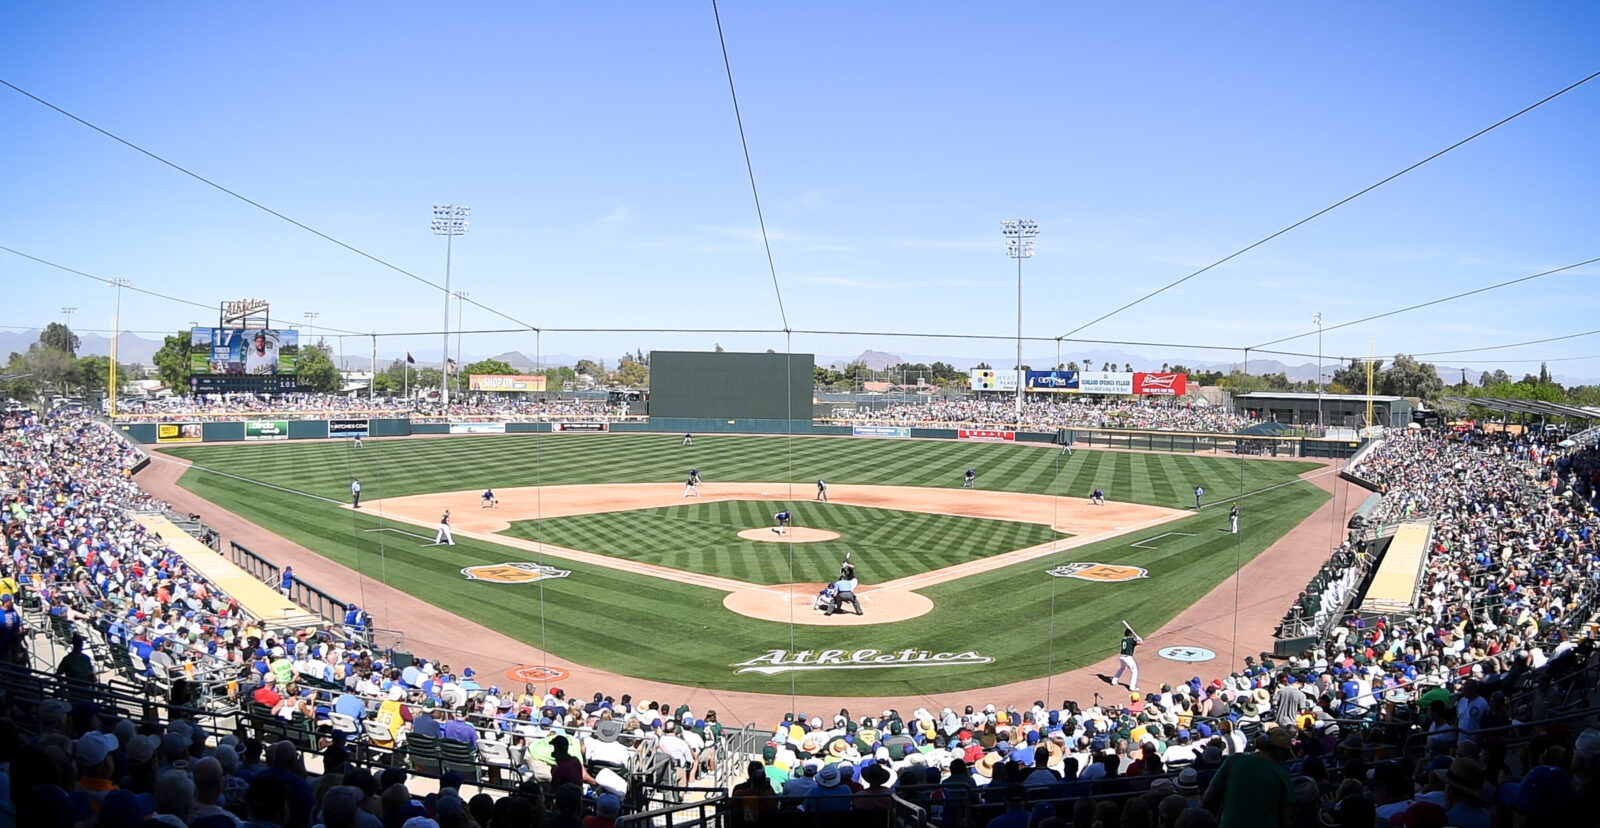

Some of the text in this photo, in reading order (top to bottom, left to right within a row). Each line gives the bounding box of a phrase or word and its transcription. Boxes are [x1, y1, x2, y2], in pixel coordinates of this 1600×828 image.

[224, 298, 270, 318] Athletics
[214, 329, 234, 346] 17
[483, 376, 502, 389] SHOP
[503, 377, 513, 389] ON
[729, 647, 996, 670] Athletics
